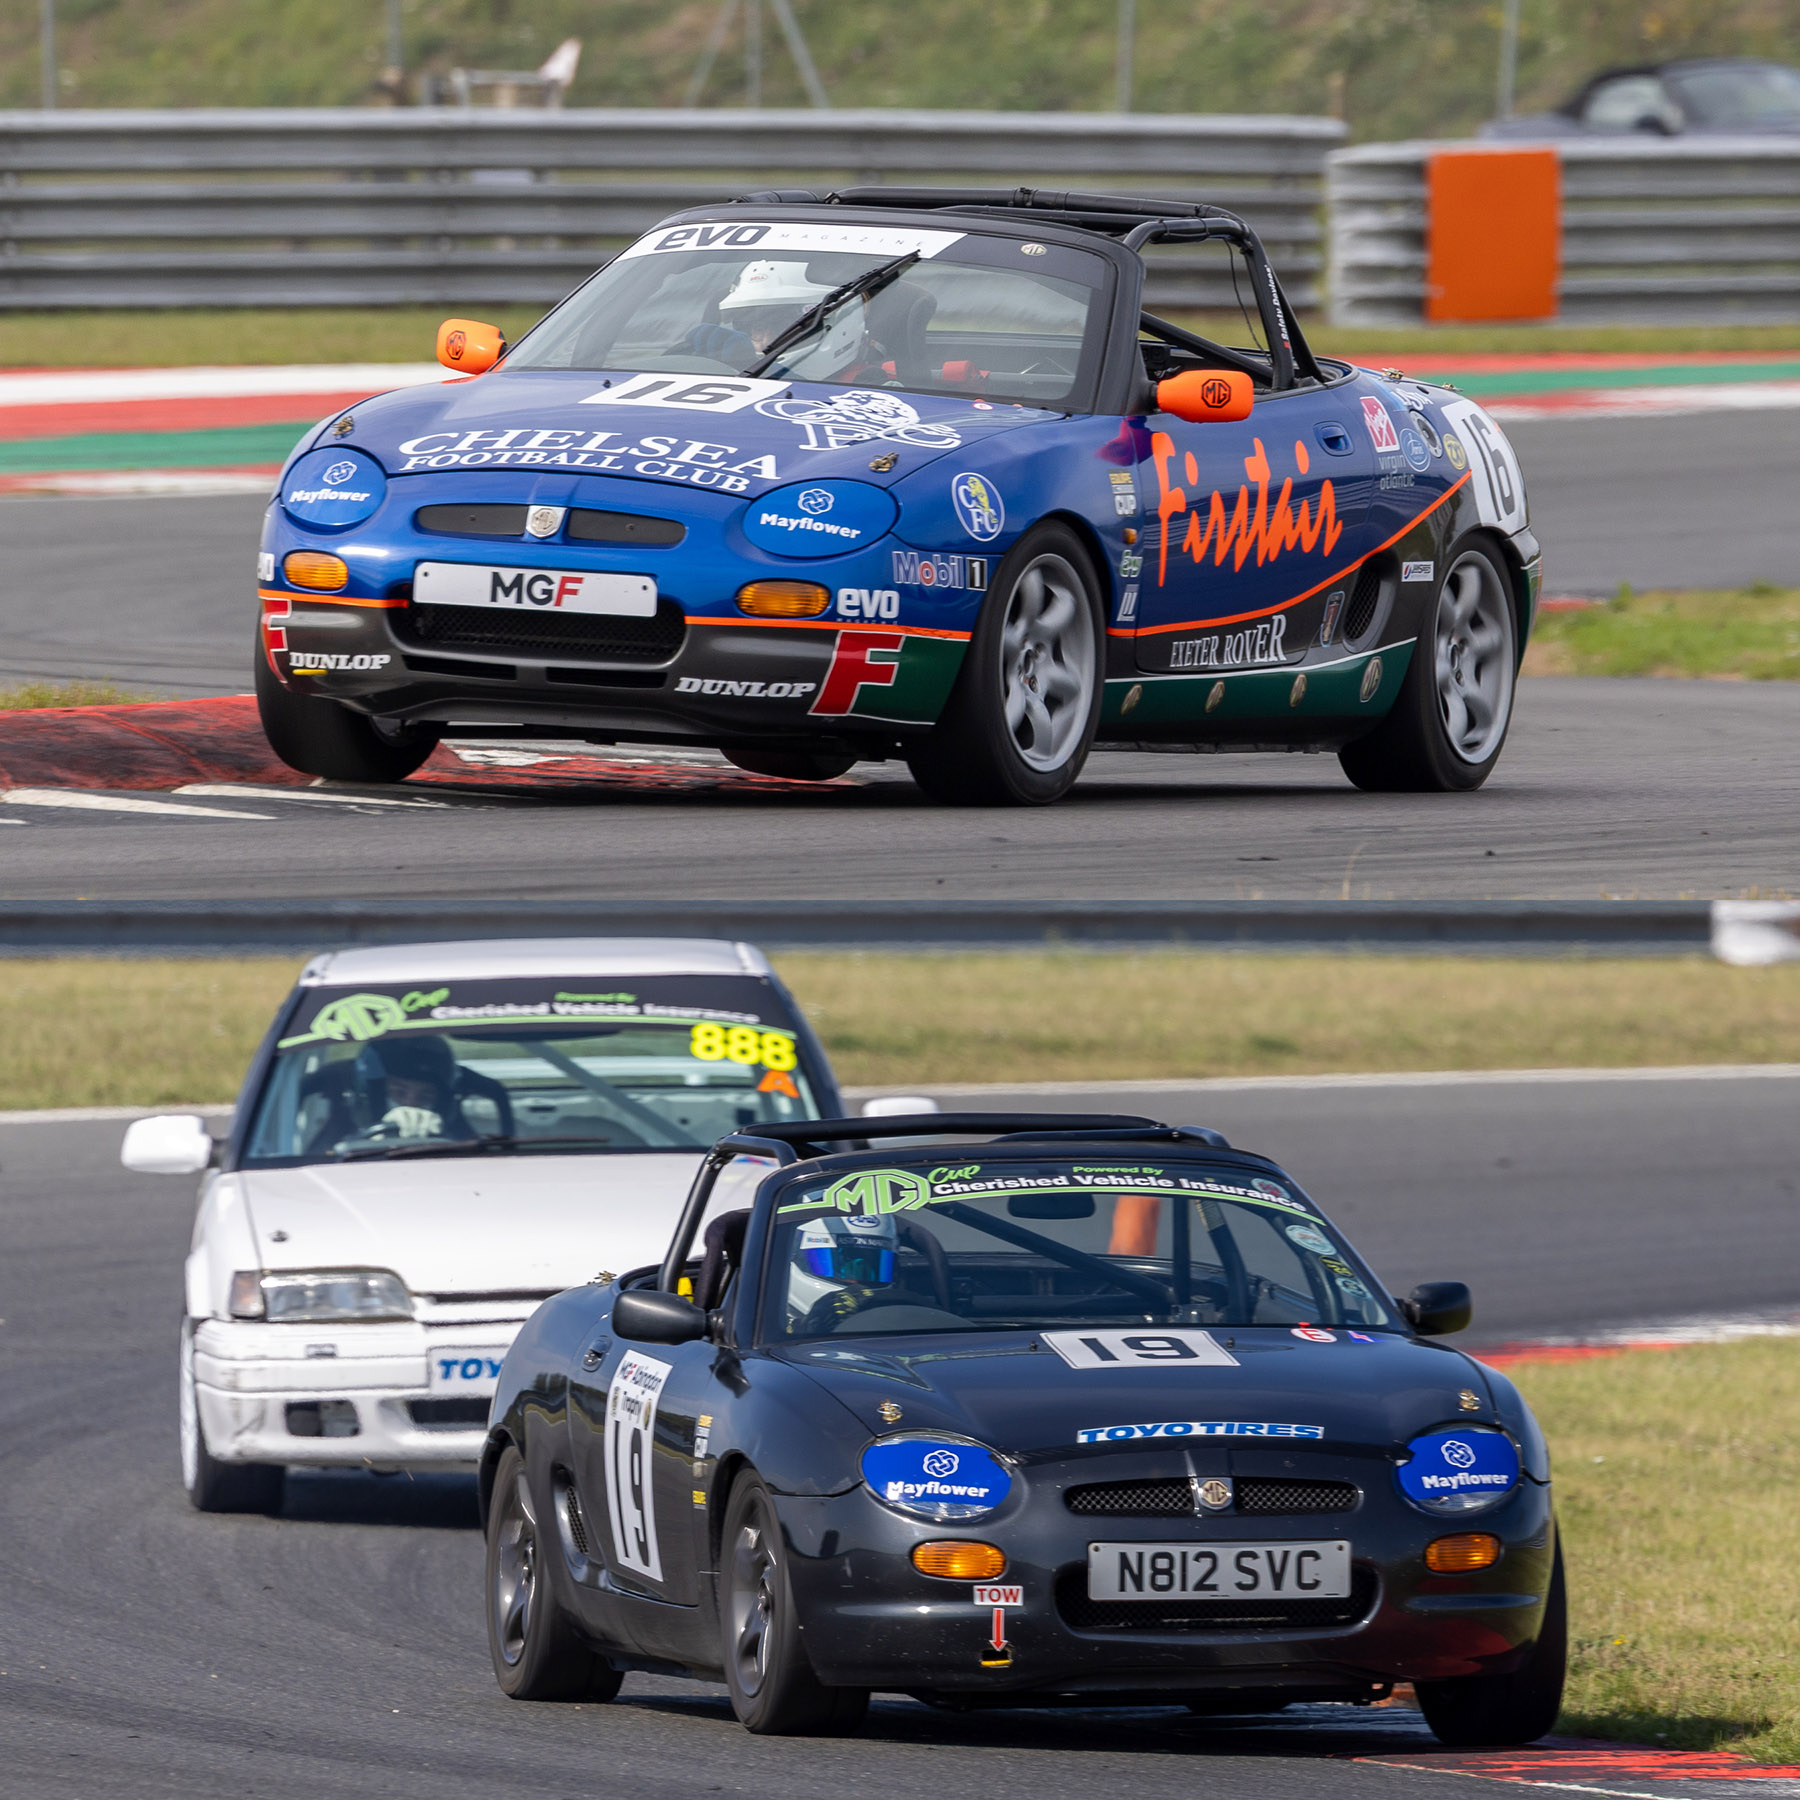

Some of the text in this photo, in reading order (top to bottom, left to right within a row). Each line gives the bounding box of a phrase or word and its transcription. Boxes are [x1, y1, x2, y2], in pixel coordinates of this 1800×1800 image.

[654, 226, 772, 250] evo
[617, 380, 752, 404] 16
[1203, 381, 1229, 406] MG
[398, 429, 782, 480] CHELSEA
[1379, 454, 1407, 473] virgin
[1461, 413, 1516, 522] 16
[399, 451, 751, 493] FOOTBALL CLUB
[1380, 474, 1415, 490] atlantic
[289, 488, 371, 504] Mayflower
[760, 512, 861, 539] Mayflower
[892, 551, 965, 590] Mobil
[490, 571, 585, 607] MGF
[836, 588, 900, 619] evo
[1169, 635, 1224, 668] EXETER
[1223, 614, 1288, 667] ROVER
[289, 651, 391, 670] DUNLOP
[807, 629, 906, 716] F
[673, 676, 817, 698] DUNLOP
[313, 995, 404, 1041] MG
[430, 1002, 761, 1024] Cherished Vehicle Insurance
[690, 1022, 798, 1072] 888
[927, 1164, 981, 1185] Cup
[1072, 1165, 1163, 1176] Powered By
[828, 1170, 929, 1215] MG
[933, 1175, 1069, 1196] Cherished
[1073, 1175, 1167, 1190] Vehicle
[1179, 1178, 1307, 1212] Insurance
[1078, 1336, 1201, 1363] 19
[1080, 1421, 1322, 1443] TOYO TIRES
[886, 1481, 990, 1500] Mayflower
[1422, 1471, 1509, 1489] Mayflower
[614, 1420, 650, 1568] 19
[1118, 1550, 1322, 1593] N812 SVC
[976, 1588, 1021, 1604] TOW
